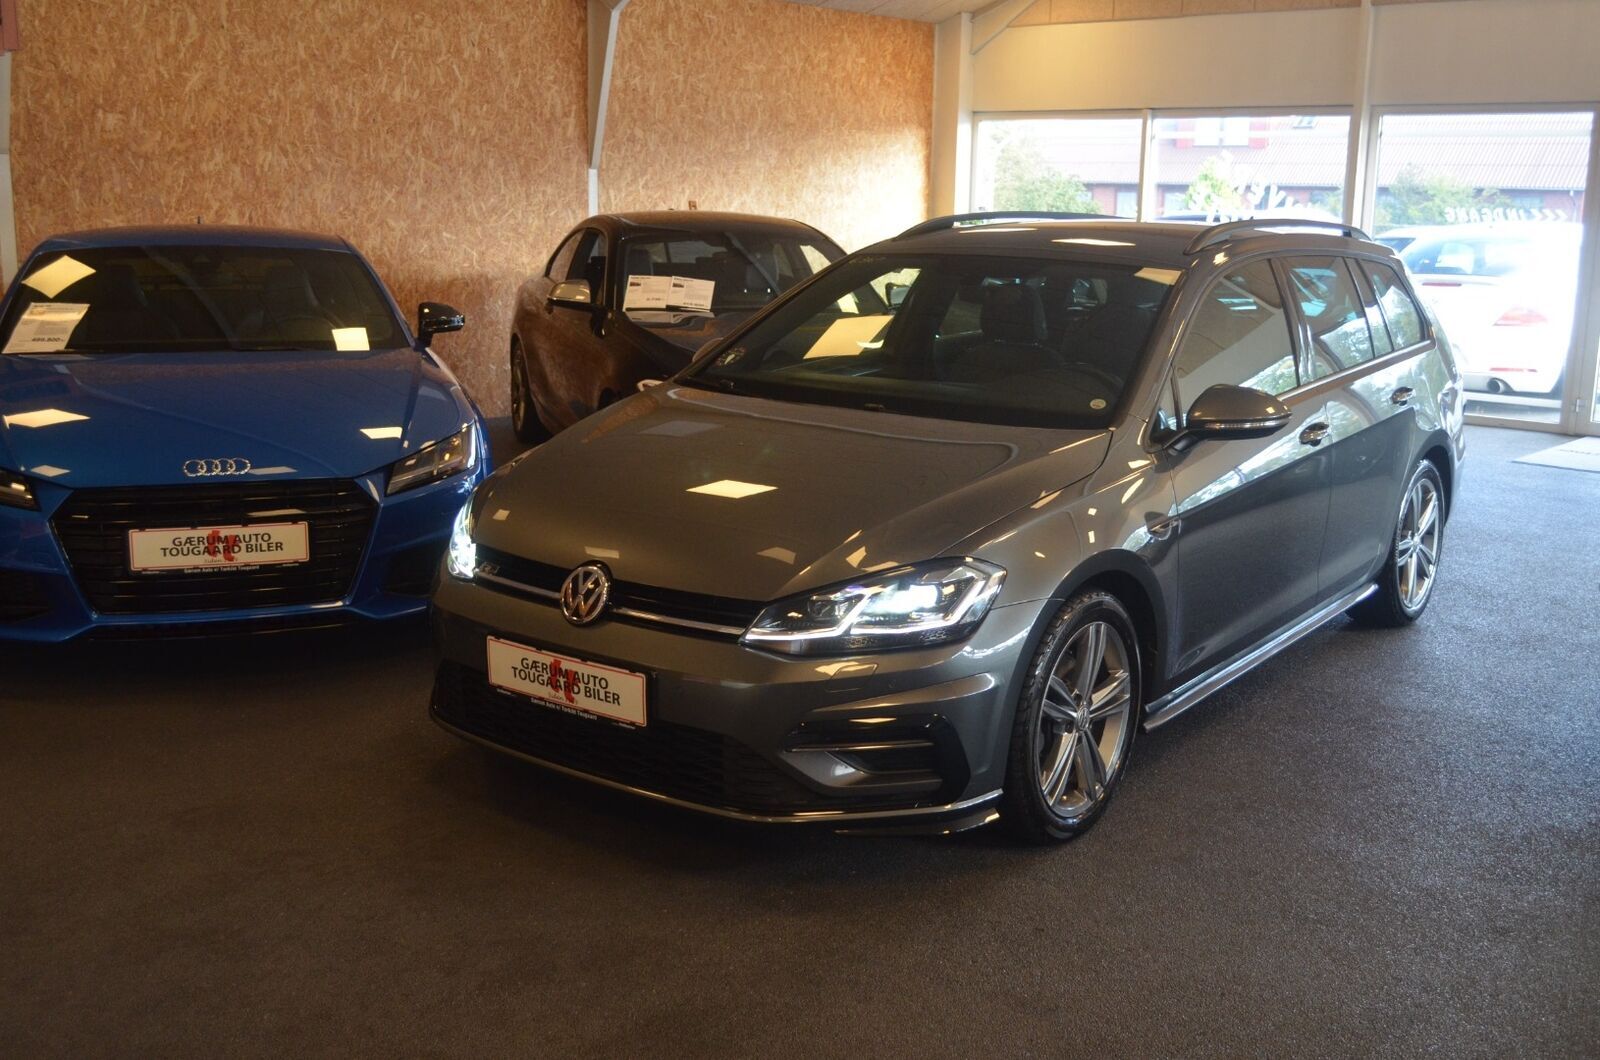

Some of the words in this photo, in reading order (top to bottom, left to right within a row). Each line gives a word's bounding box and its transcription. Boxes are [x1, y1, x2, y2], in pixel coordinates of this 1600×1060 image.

[161, 544, 242, 557] TOUGAARD
[245, 541, 284, 553] BILER
[172, 535, 229, 547] GÆRUM
[234, 533, 272, 544] AUTO
[520, 657, 569, 679] GÆRUM
[573, 671, 609, 690] AUTO
[511, 666, 581, 695] TOUGAARD
[584, 687, 621, 706] BILER
